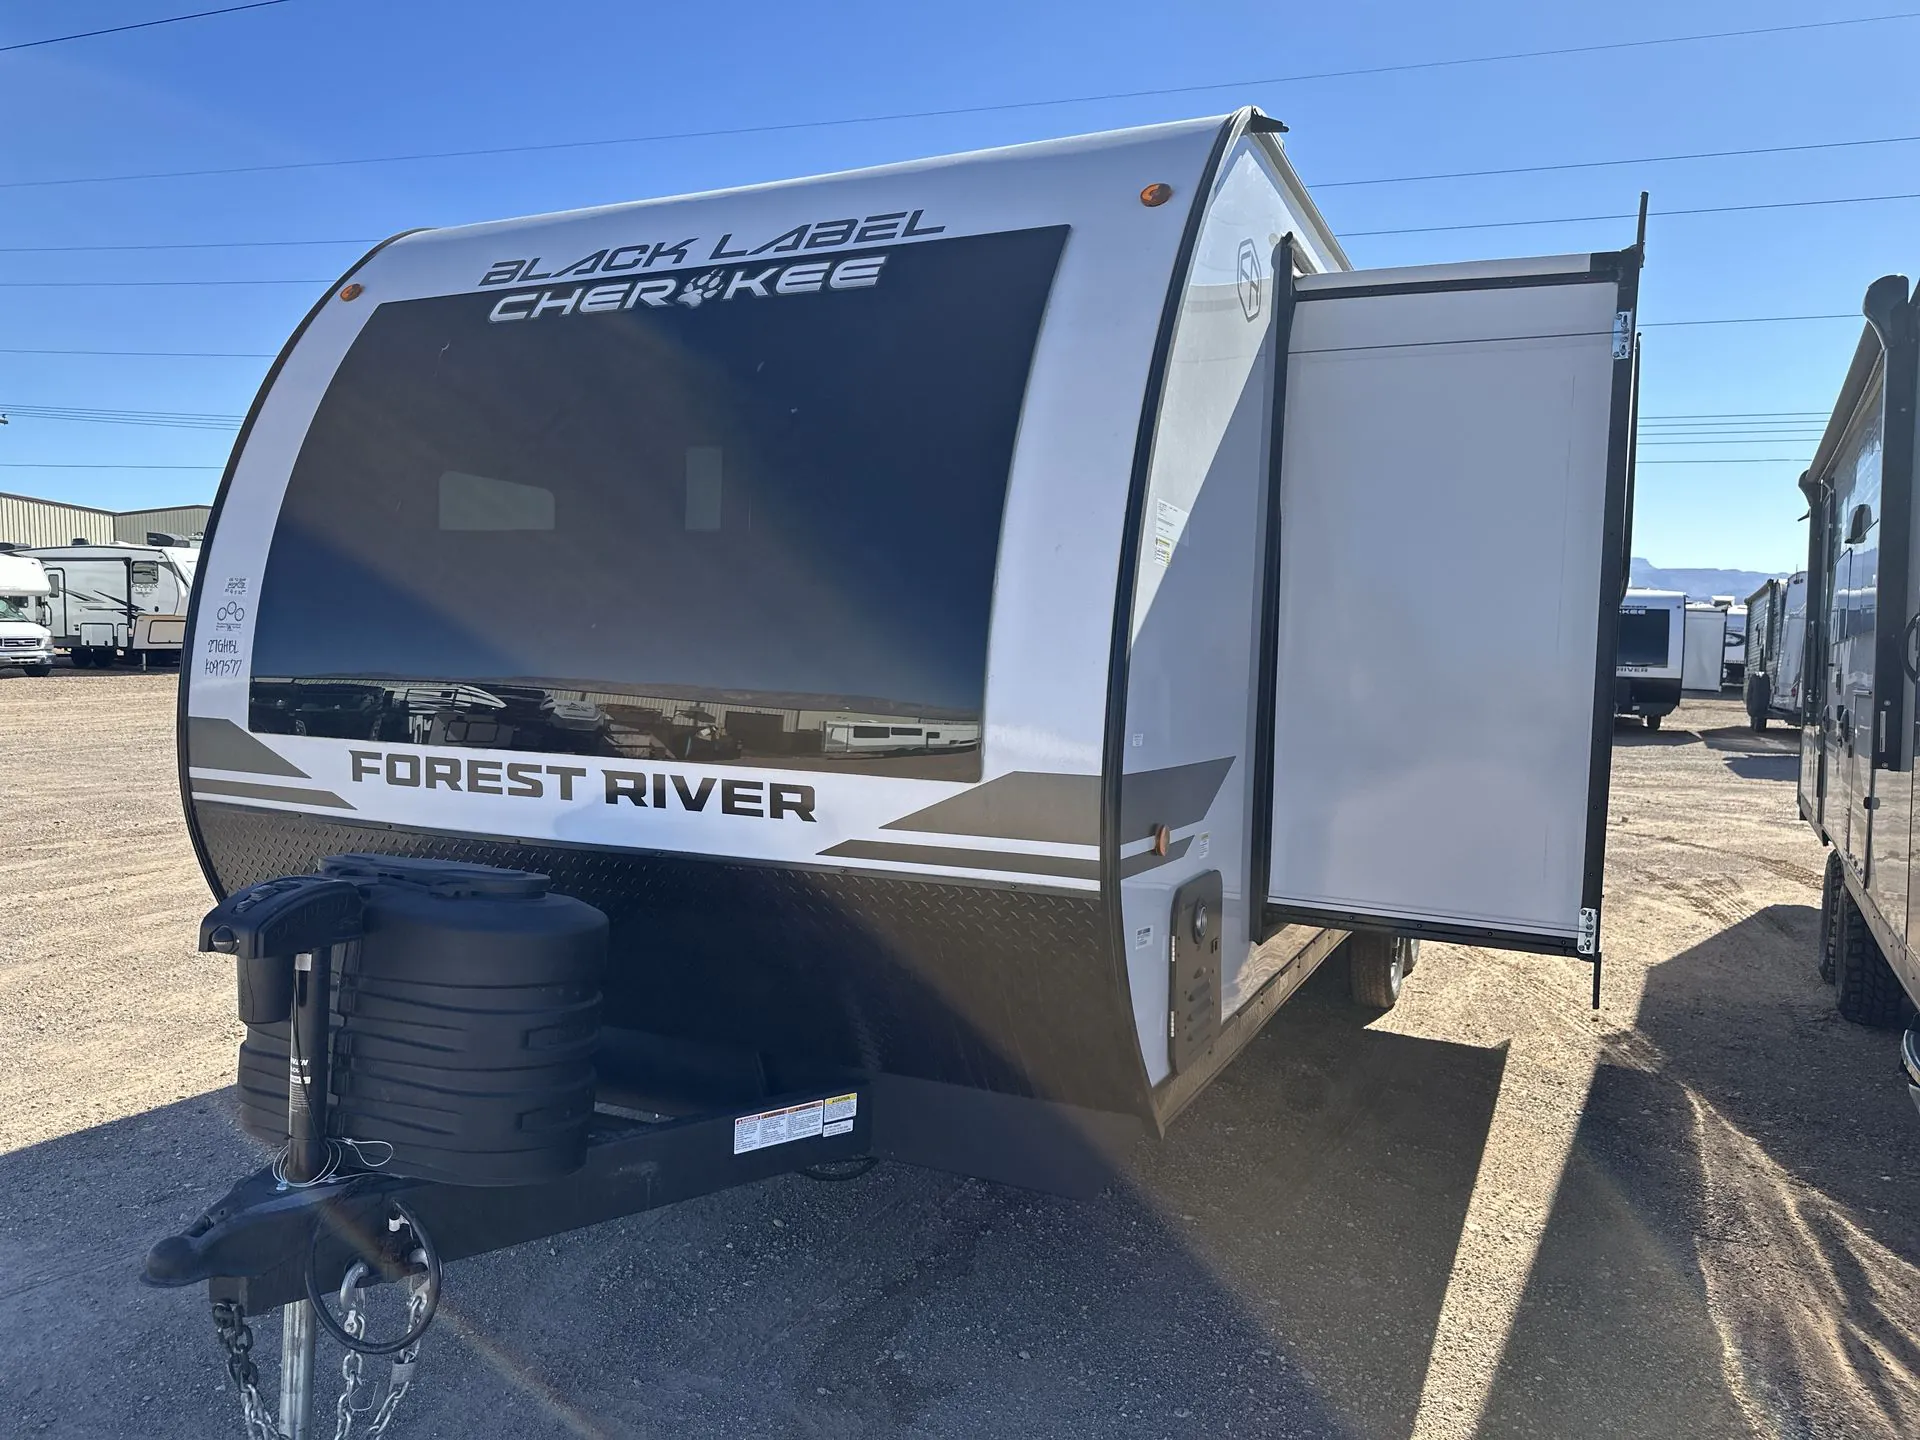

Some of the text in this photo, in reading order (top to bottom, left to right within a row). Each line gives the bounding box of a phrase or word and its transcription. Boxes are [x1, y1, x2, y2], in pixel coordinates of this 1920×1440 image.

[479, 209, 946, 286] BLACK LABEL
[349, 750, 817, 822] FOREST RIVER
